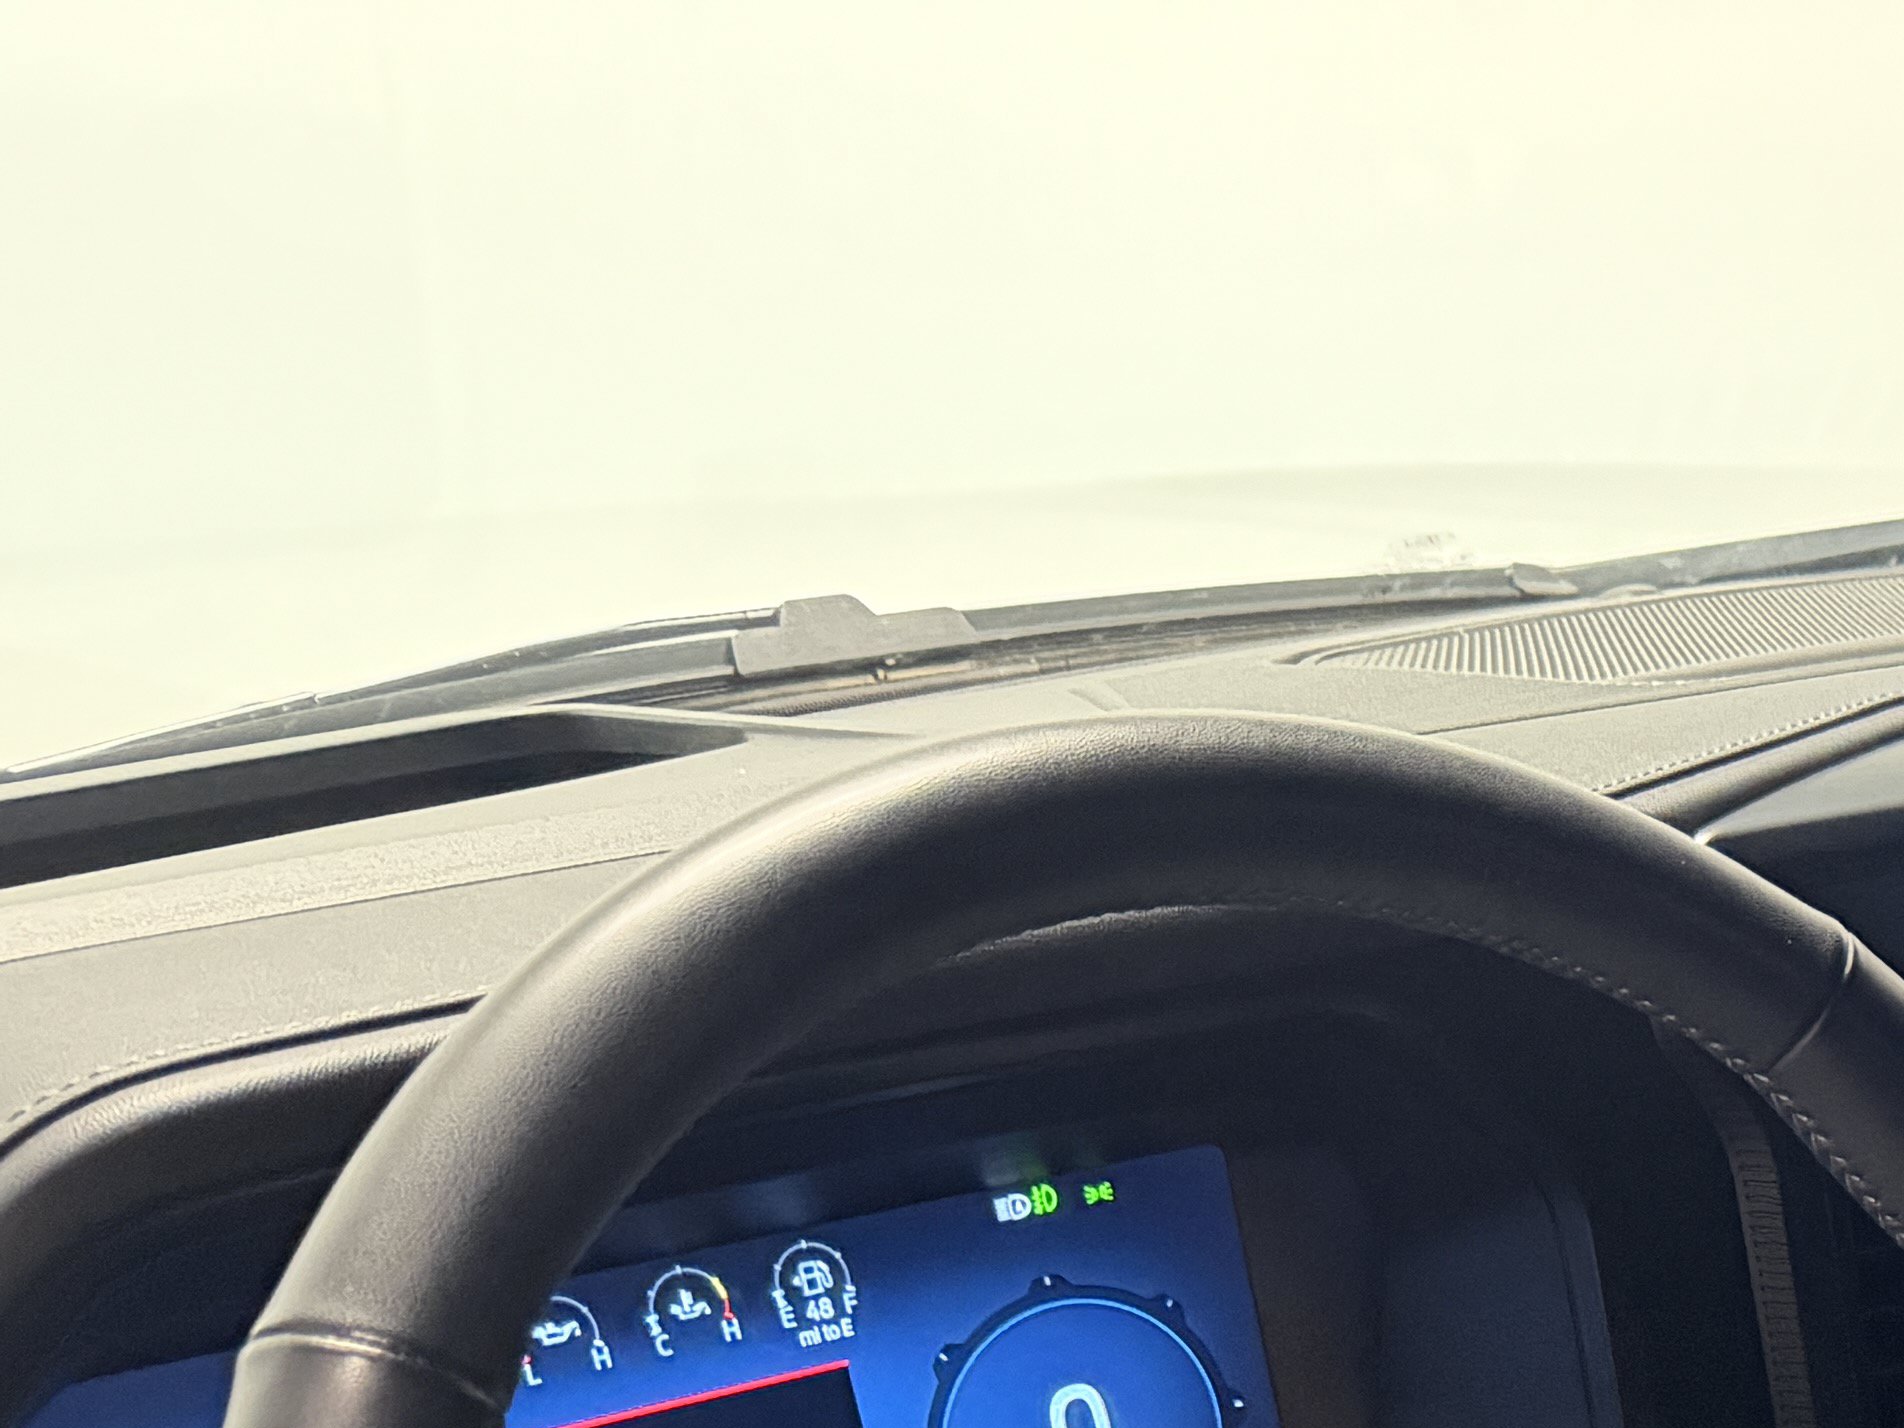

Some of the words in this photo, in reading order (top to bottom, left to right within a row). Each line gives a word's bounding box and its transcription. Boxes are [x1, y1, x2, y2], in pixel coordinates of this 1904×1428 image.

[778, 1306, 798, 1329] E
[805, 1297, 835, 1322] 48
[720, 1317, 743, 1342] H
[590, 1344, 613, 1371] H
[655, 1334, 674, 1357] C
[522, 1364, 542, 1386] L
